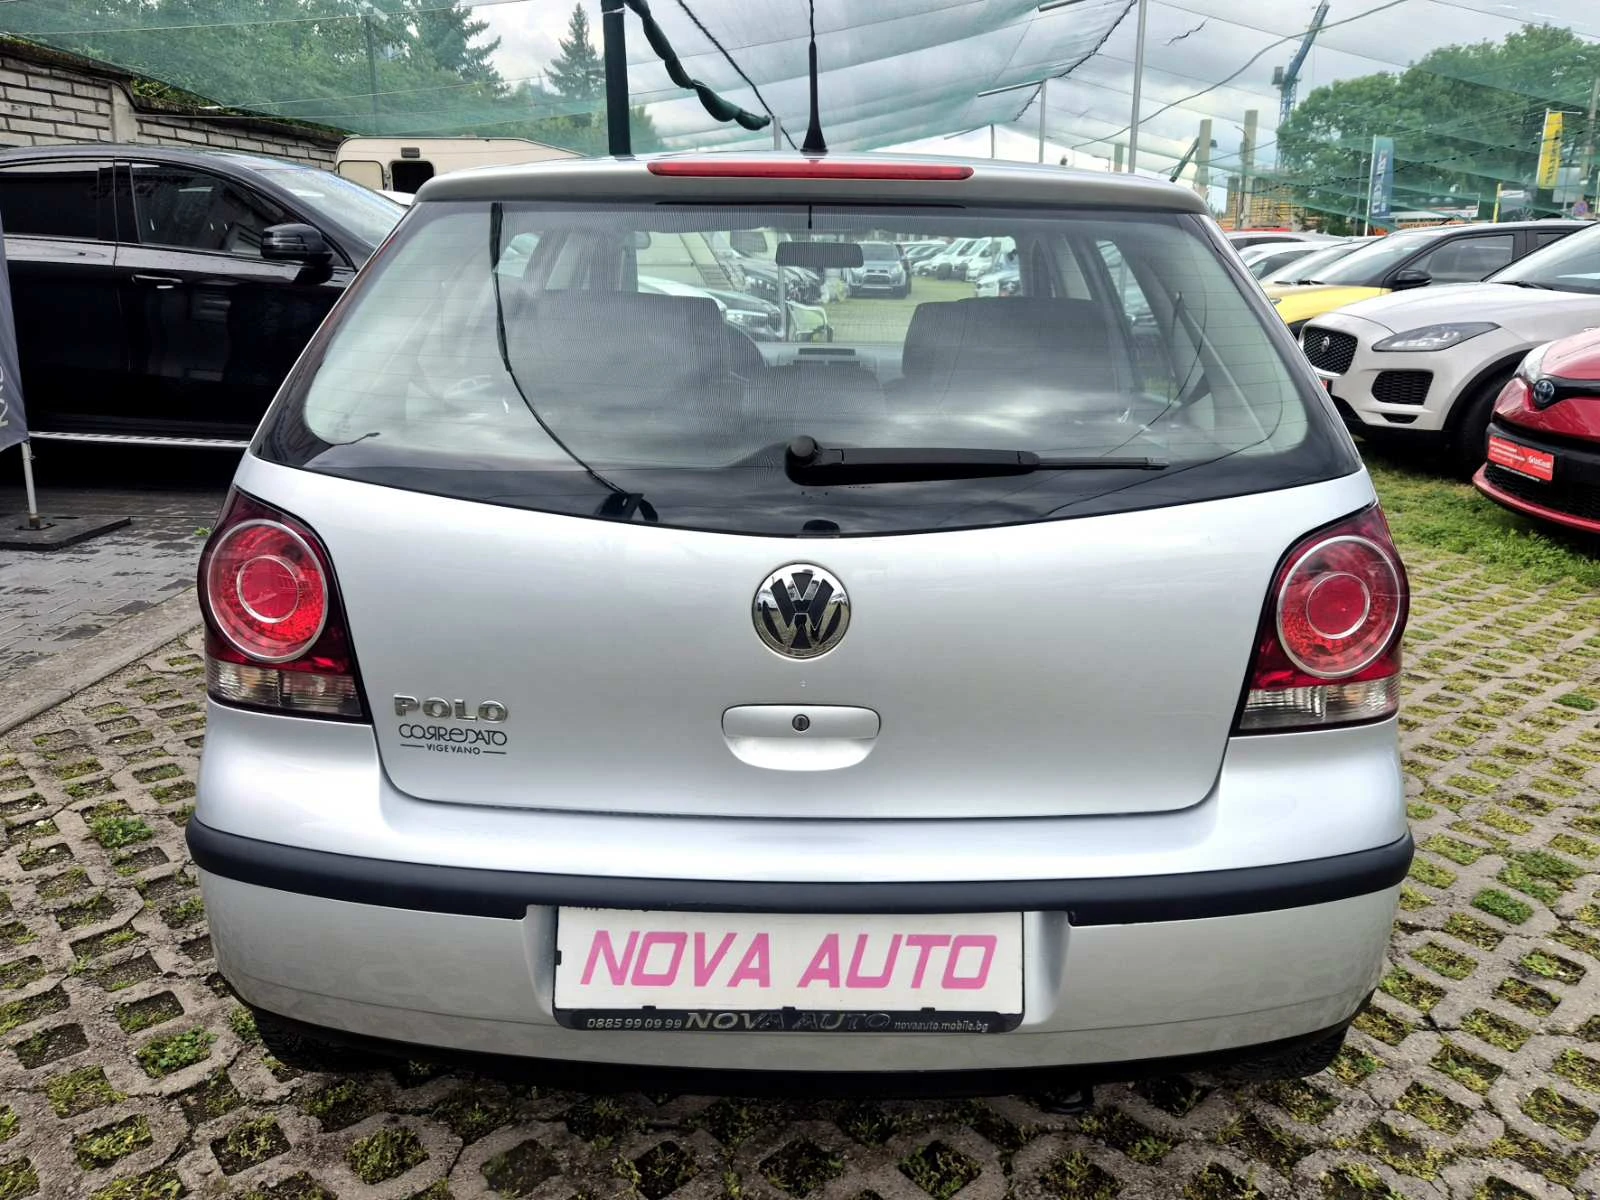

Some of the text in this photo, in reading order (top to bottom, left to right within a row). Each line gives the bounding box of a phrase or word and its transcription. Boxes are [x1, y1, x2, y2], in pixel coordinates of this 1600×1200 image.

[393, 693, 509, 724] POLO
[426, 743, 481, 756] VIGEVANO
[580, 929, 998, 990] NOVA AUTO
[586, 1017, 682, 1030] 0885 99 09 99
[684, 1011, 892, 1031] NOVA AUTO
[893, 1019, 989, 1033] novaauto.mobile.bg
